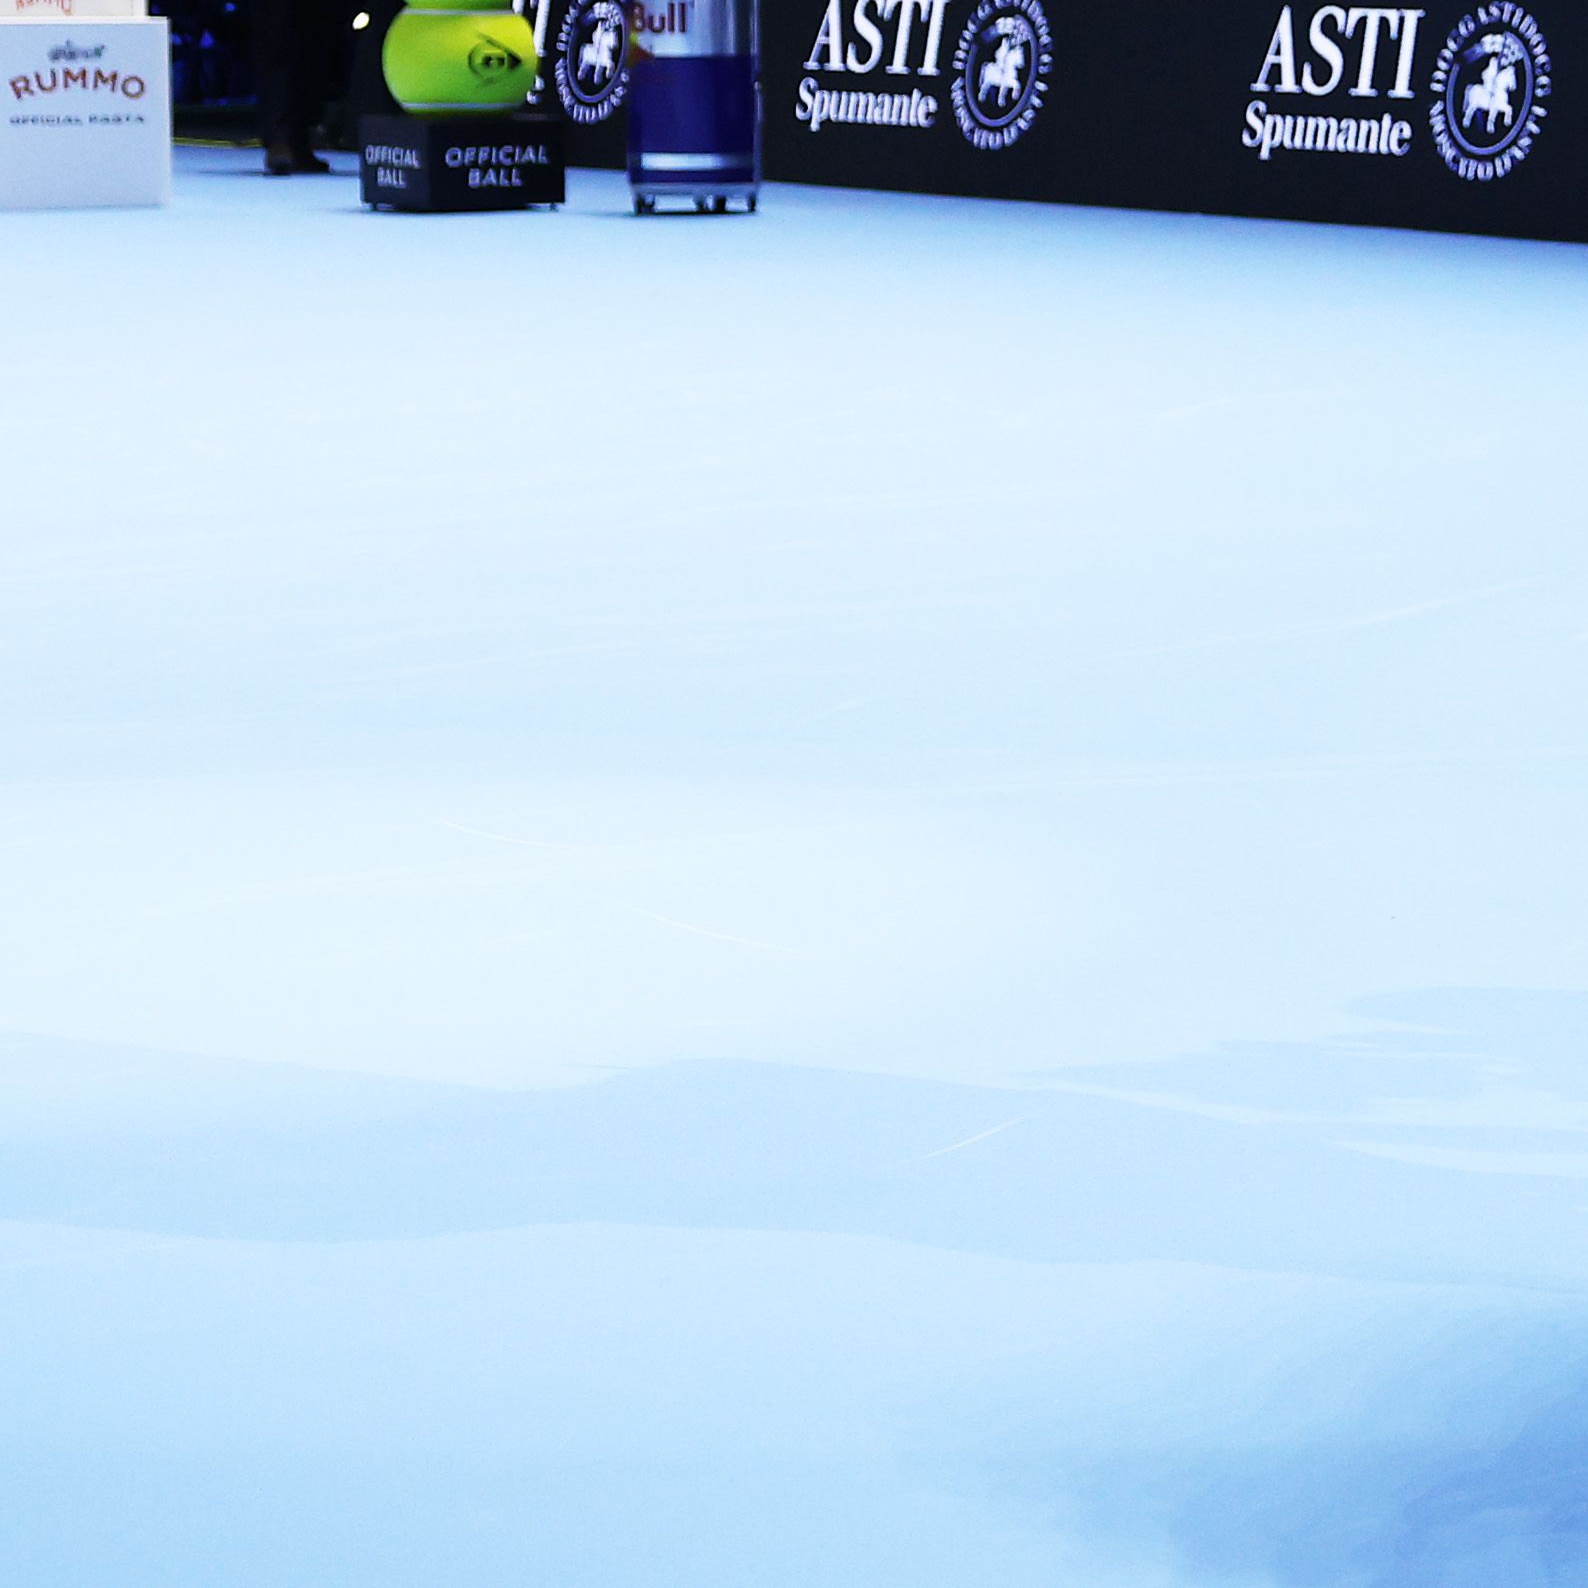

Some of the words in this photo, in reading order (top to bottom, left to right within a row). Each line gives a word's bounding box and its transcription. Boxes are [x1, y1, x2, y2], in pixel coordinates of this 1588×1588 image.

[1250, 4, 1426, 99] ASTI
[9, 67, 145, 101] RUMMO
[795, 76, 938, 132] Spumante
[1242, 99, 1412, 160] Spumante
[365, 145, 421, 169] OFFICIAL
[445, 145, 548, 167] OFFICIAL
[377, 166, 406, 188] BALL
[468, 168, 523, 188] BALL
